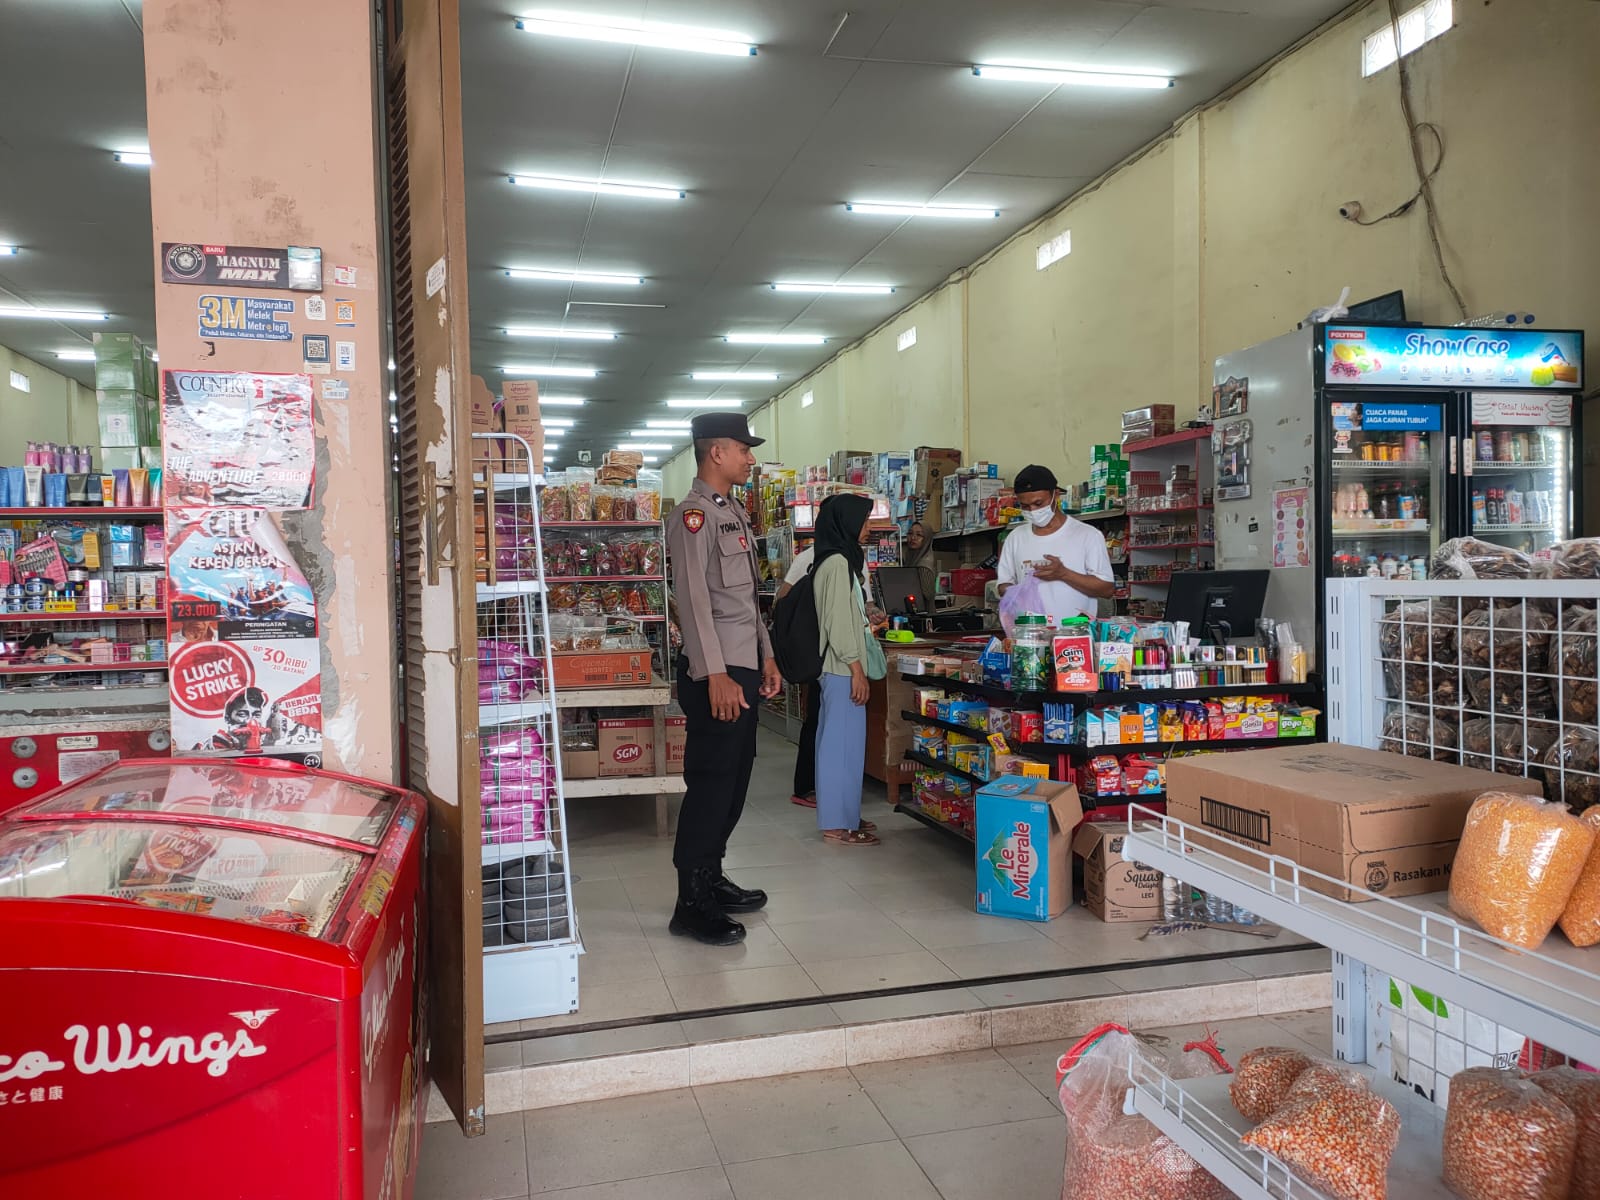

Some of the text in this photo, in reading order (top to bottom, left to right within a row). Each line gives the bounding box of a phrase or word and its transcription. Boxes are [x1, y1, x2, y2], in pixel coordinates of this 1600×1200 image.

[216, 255, 280, 269] MAGNUM
[218, 268, 279, 282] MAX
[247, 299, 292, 310] Masyarakat
[201, 296, 247, 330] 3M
[247, 309, 271, 319] Melek
[1330, 331, 1364, 339] POLYTRON
[179, 375, 249, 394] COUNTRY
[169, 456, 192, 469] THE
[188, 555, 233, 569] KEREN
[177, 604, 218, 617] 23.000
[262, 647, 286, 664] 30
[285, 658, 308, 669] RIBU
[1062, 648, 1083, 657] Gim
[182, 656, 234, 684] LUCKY
[185, 674, 242, 701] STRIKE
[287, 707, 319, 718] BEDA
[616, 747, 639, 760] SGM
[305, 758, 319, 766] 21+
[996, 848, 1015, 871] Le
[1011, 821, 1031, 900] Minerale
[1393, 867, 1441, 883] Rasakan
[1138, 882, 1160, 891] Delight
[64, 1022, 267, 1077] Wings
